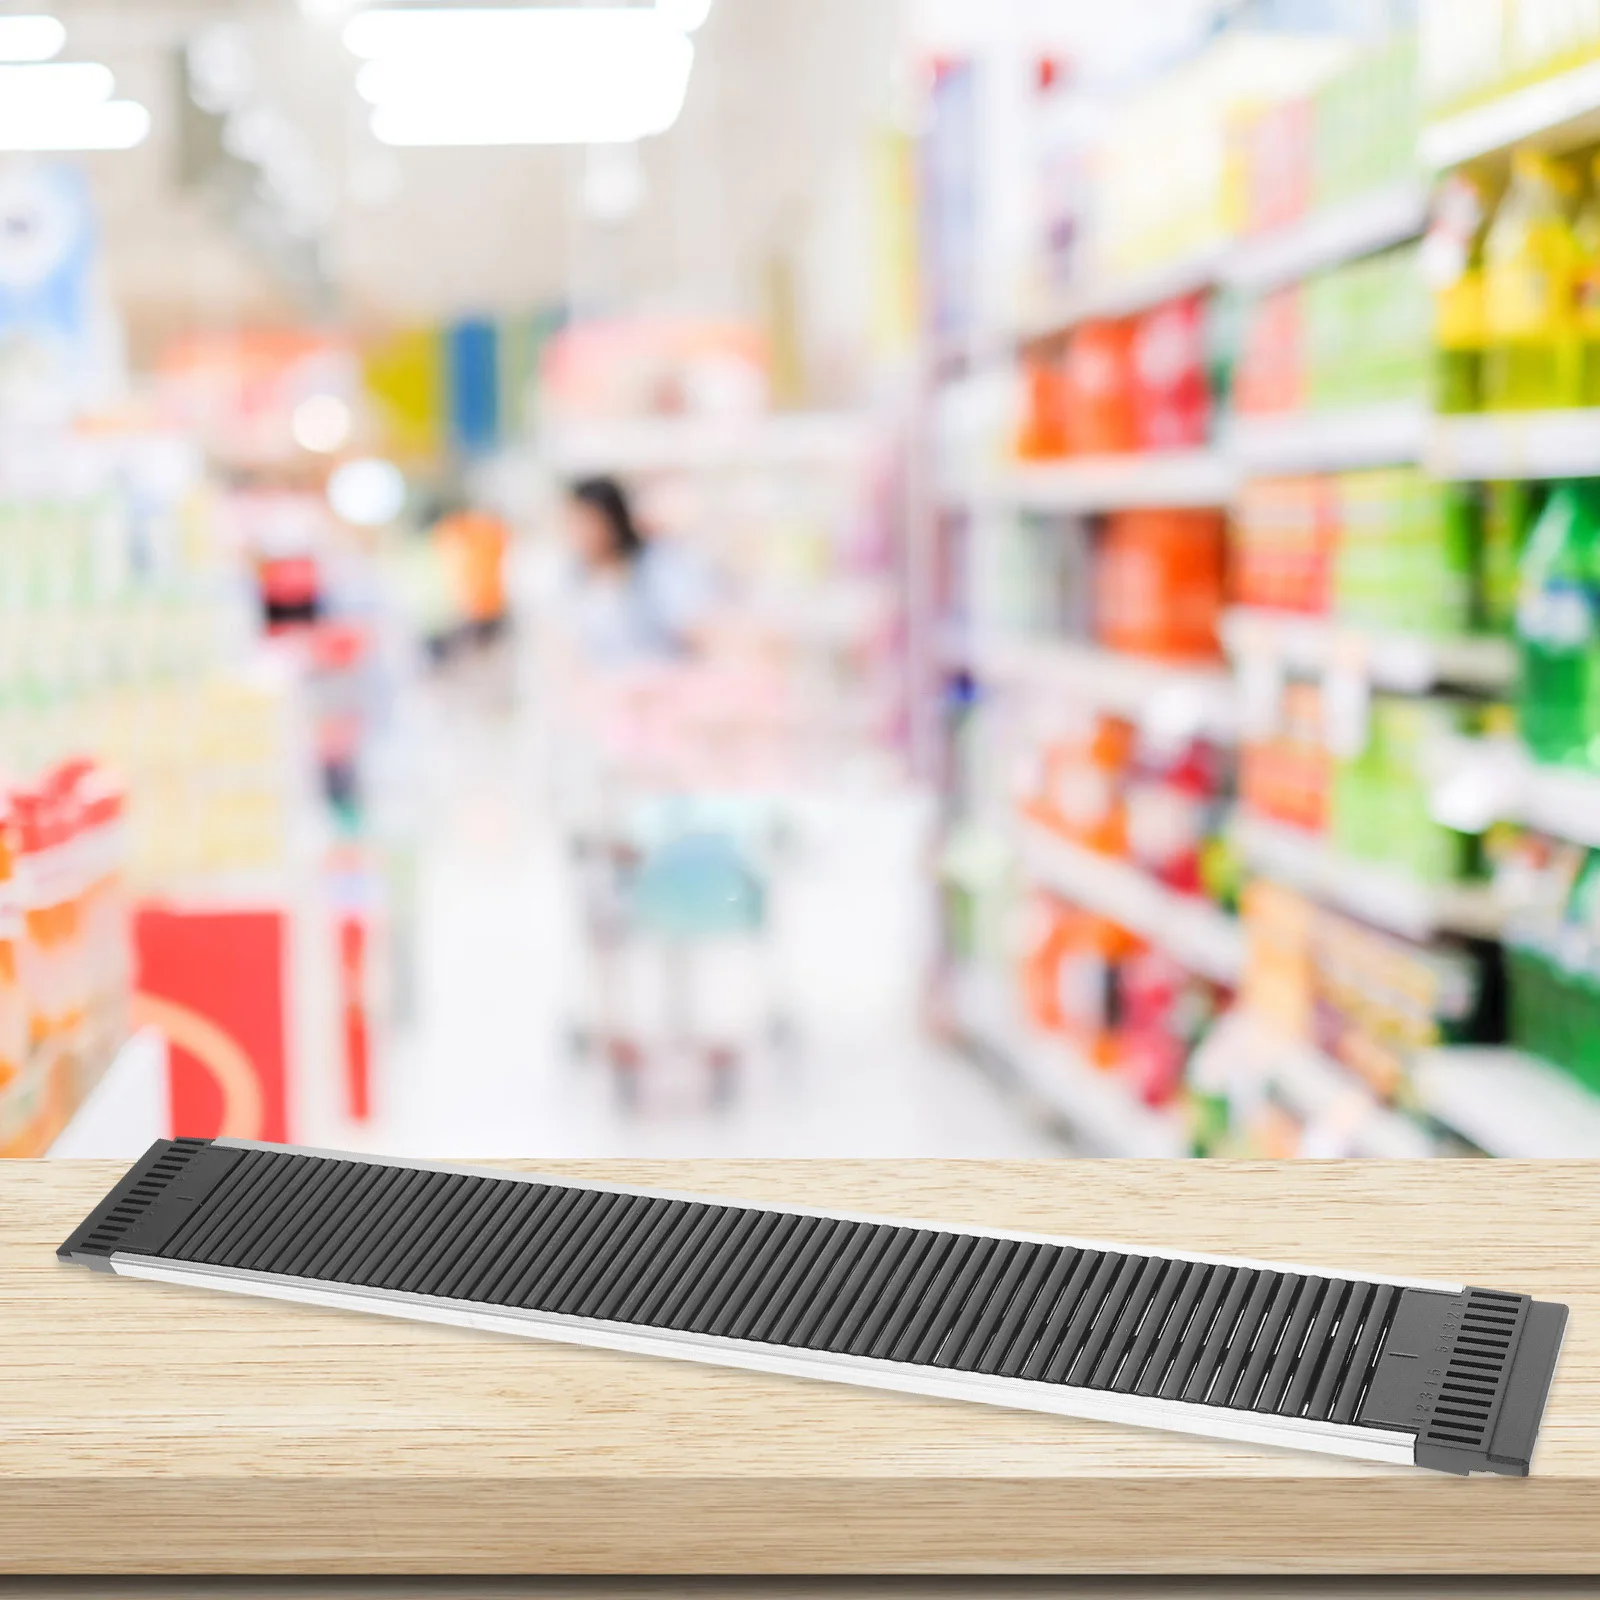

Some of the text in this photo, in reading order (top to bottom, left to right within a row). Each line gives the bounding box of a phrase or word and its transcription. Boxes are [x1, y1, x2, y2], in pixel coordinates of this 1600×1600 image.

[1446, 1311, 1459, 1320] 2
[1442, 1321, 1456, 1331] 3
[1420, 1391, 1434, 1400] 3
[1416, 1404, 1431, 1412] 2
